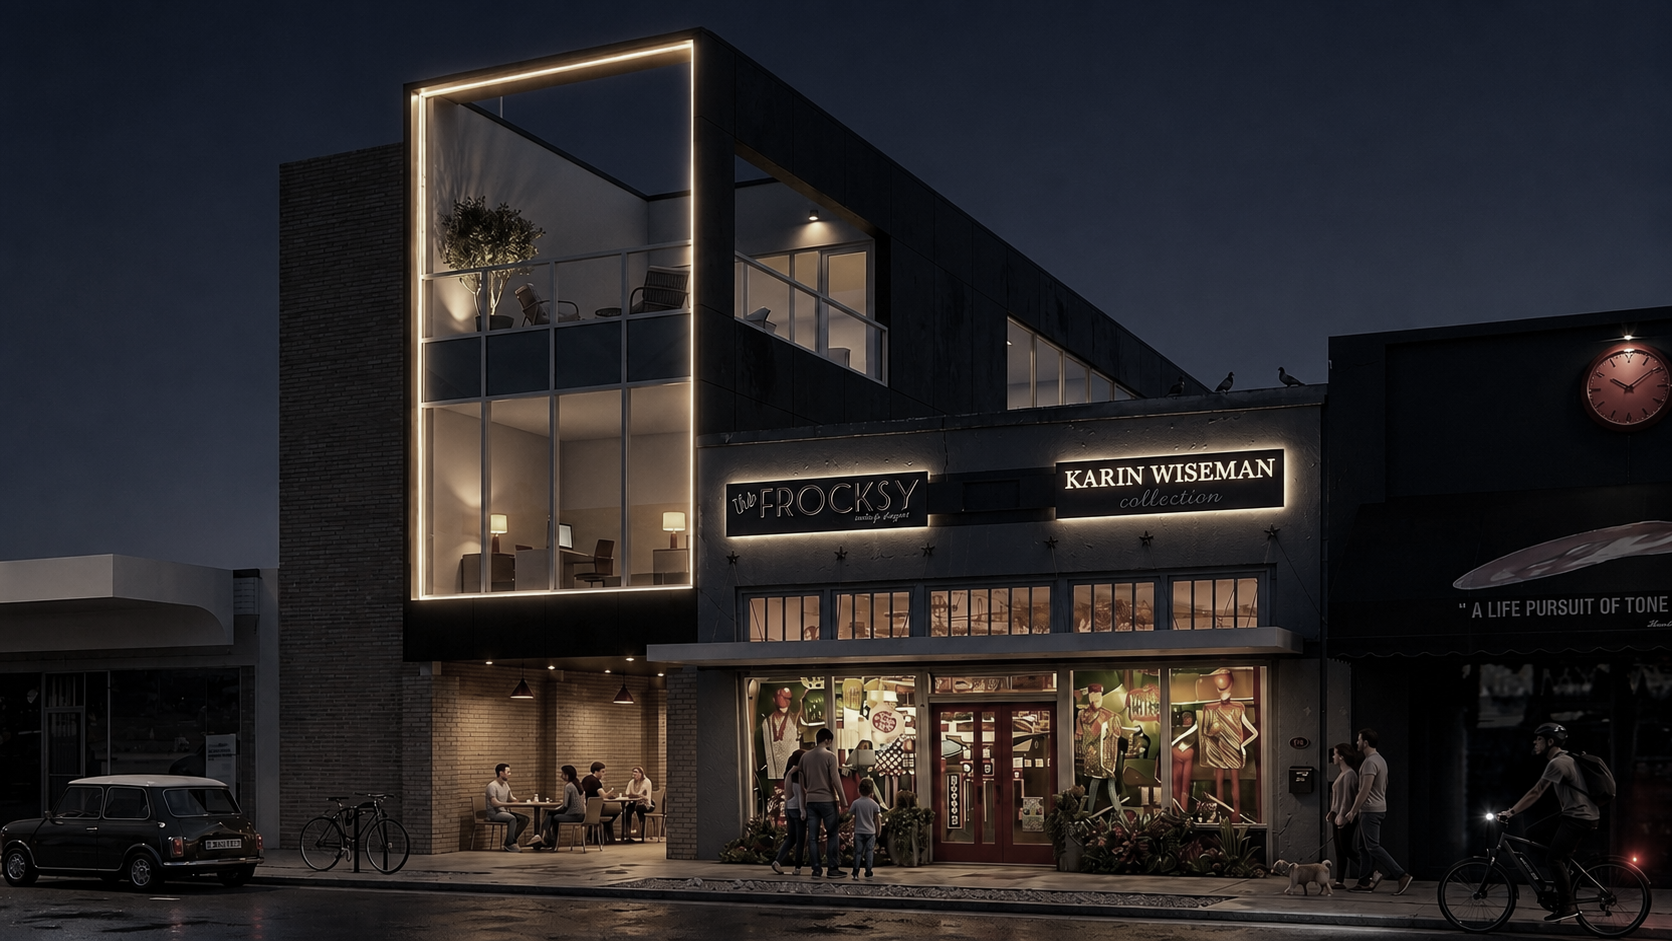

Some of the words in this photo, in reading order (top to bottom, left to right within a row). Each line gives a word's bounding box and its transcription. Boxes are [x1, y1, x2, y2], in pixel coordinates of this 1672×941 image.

[1064, 465, 1146, 490] KARIN
[1149, 457, 1276, 485] WISEMAN
[759, 478, 920, 519] FROCKSY
[1118, 488, 1223, 509] collection
[1471, 601, 1483, 619] A
[1487, 600, 1521, 619] LIFE
[1525, 597, 1595, 617] PURSUIT
[1599, 596, 1621, 615] OF
[1624, 595, 1669, 614] TONE
